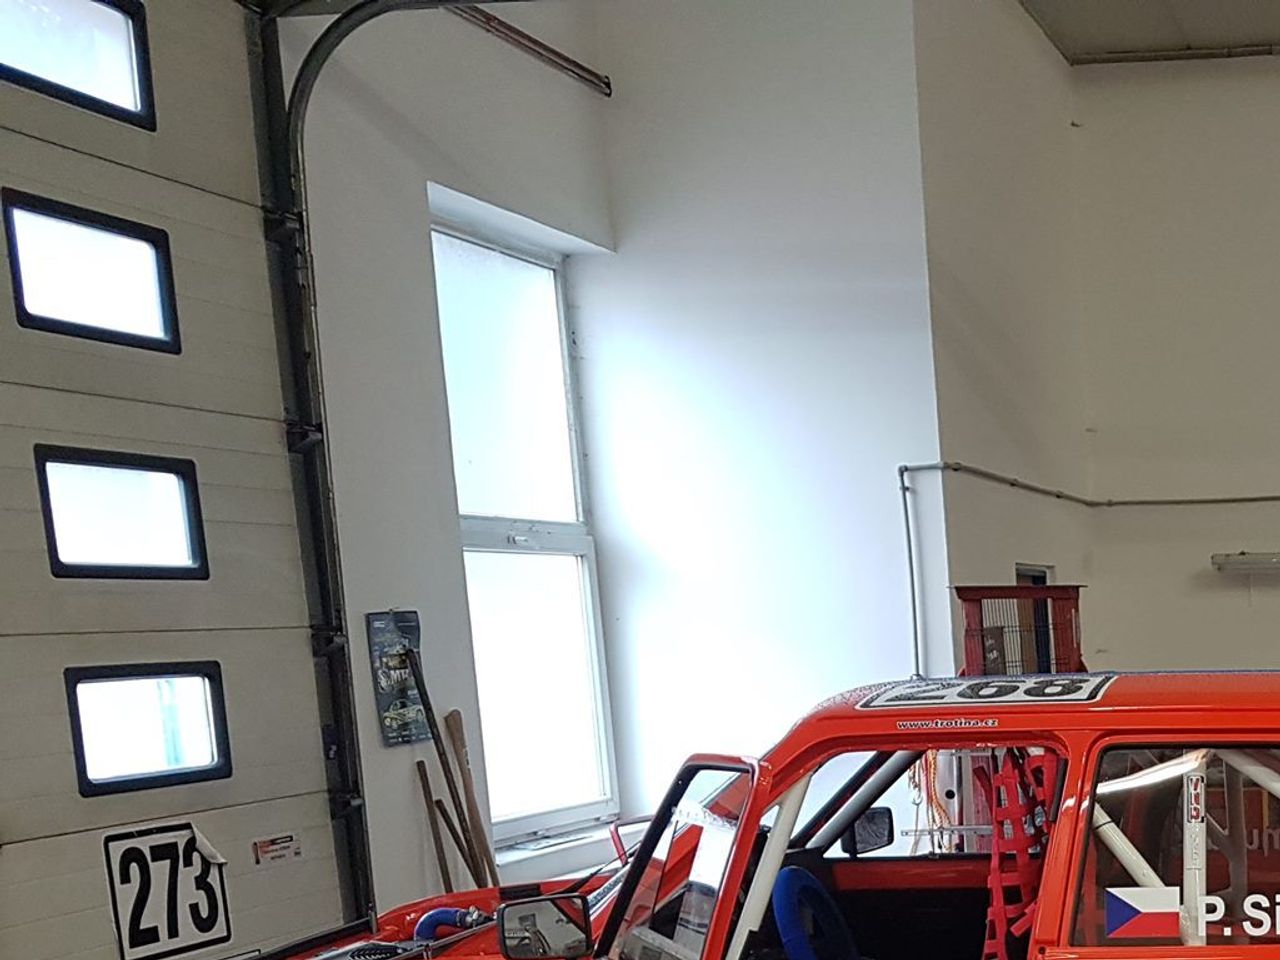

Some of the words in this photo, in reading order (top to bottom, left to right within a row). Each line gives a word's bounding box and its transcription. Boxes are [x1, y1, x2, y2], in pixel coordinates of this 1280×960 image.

[885, 678, 1091, 701] 268
[897, 718, 999, 730] www.trotina.cz
[119, 836, 219, 949] 273
[1198, 895, 1231, 937] P.
